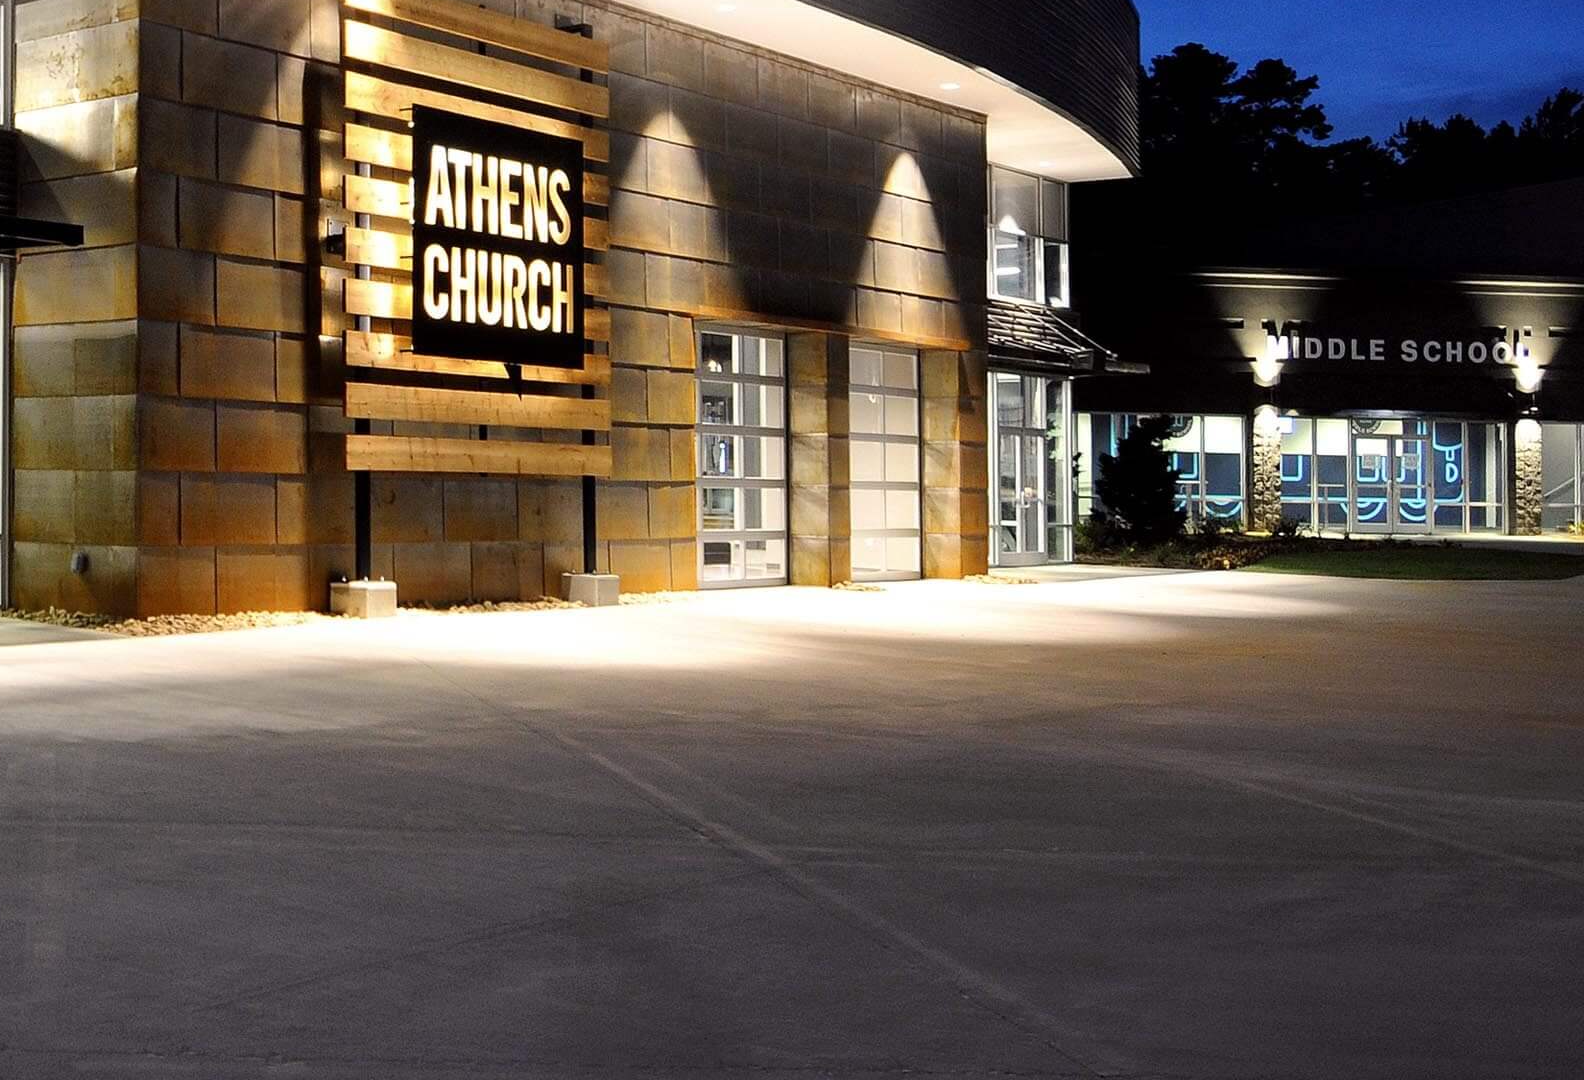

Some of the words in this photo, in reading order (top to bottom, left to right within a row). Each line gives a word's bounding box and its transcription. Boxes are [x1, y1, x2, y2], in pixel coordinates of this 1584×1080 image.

[424, 144, 571, 245] ATHENS
[423, 243, 574, 333] CHURCH
[1267, 335, 1386, 360] MIDDLE
